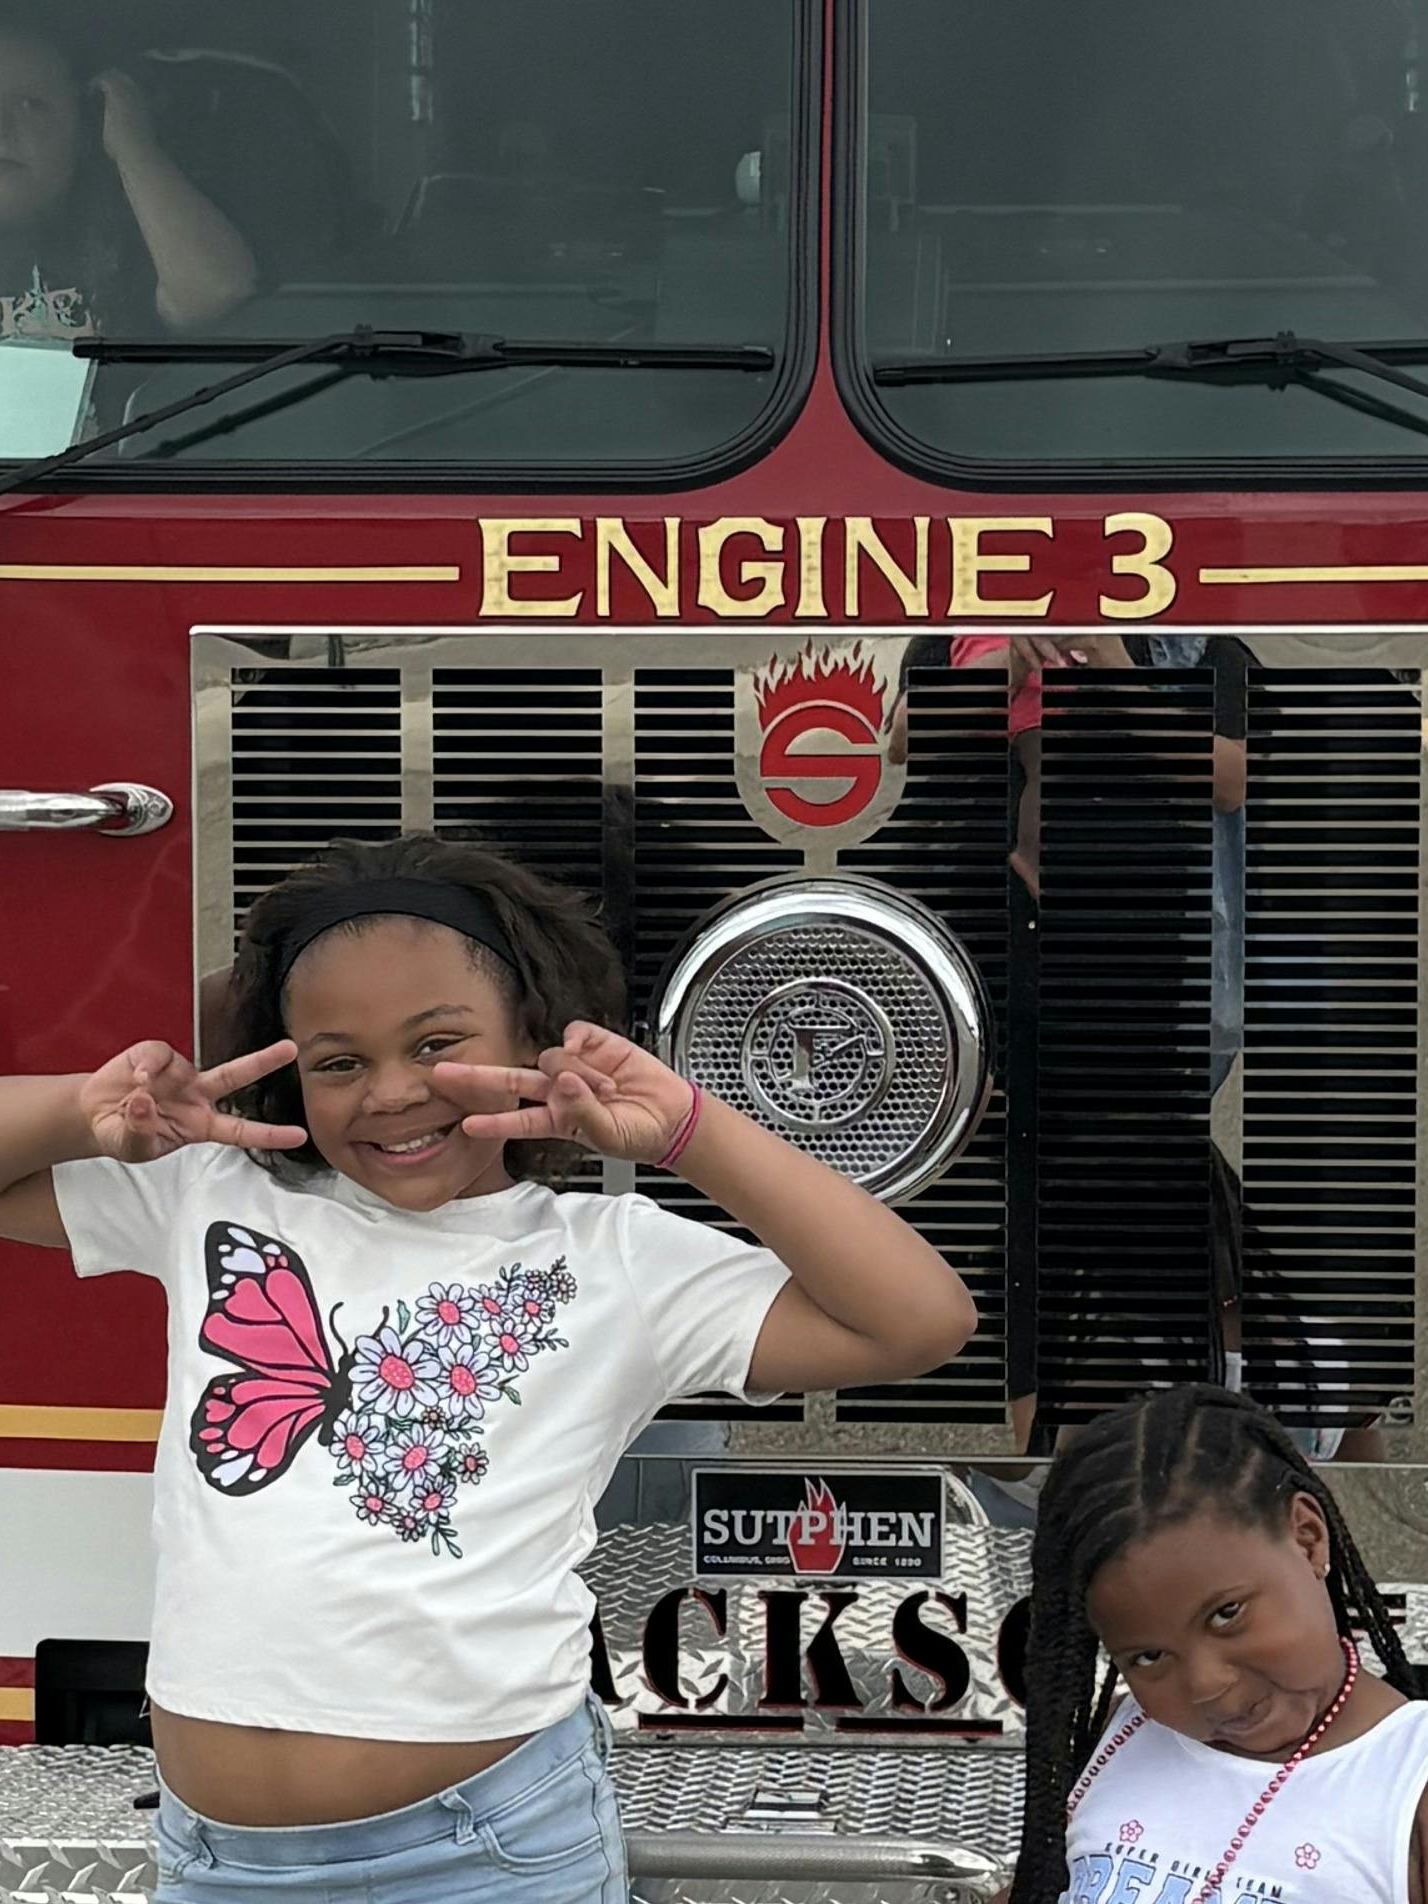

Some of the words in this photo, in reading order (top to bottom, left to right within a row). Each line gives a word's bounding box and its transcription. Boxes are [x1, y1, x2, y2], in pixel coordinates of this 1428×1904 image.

[477, 515, 1055, 618] ENGINE
[1098, 510, 1178, 620] 3
[702, 1507, 936, 1548] SUTPHEN
